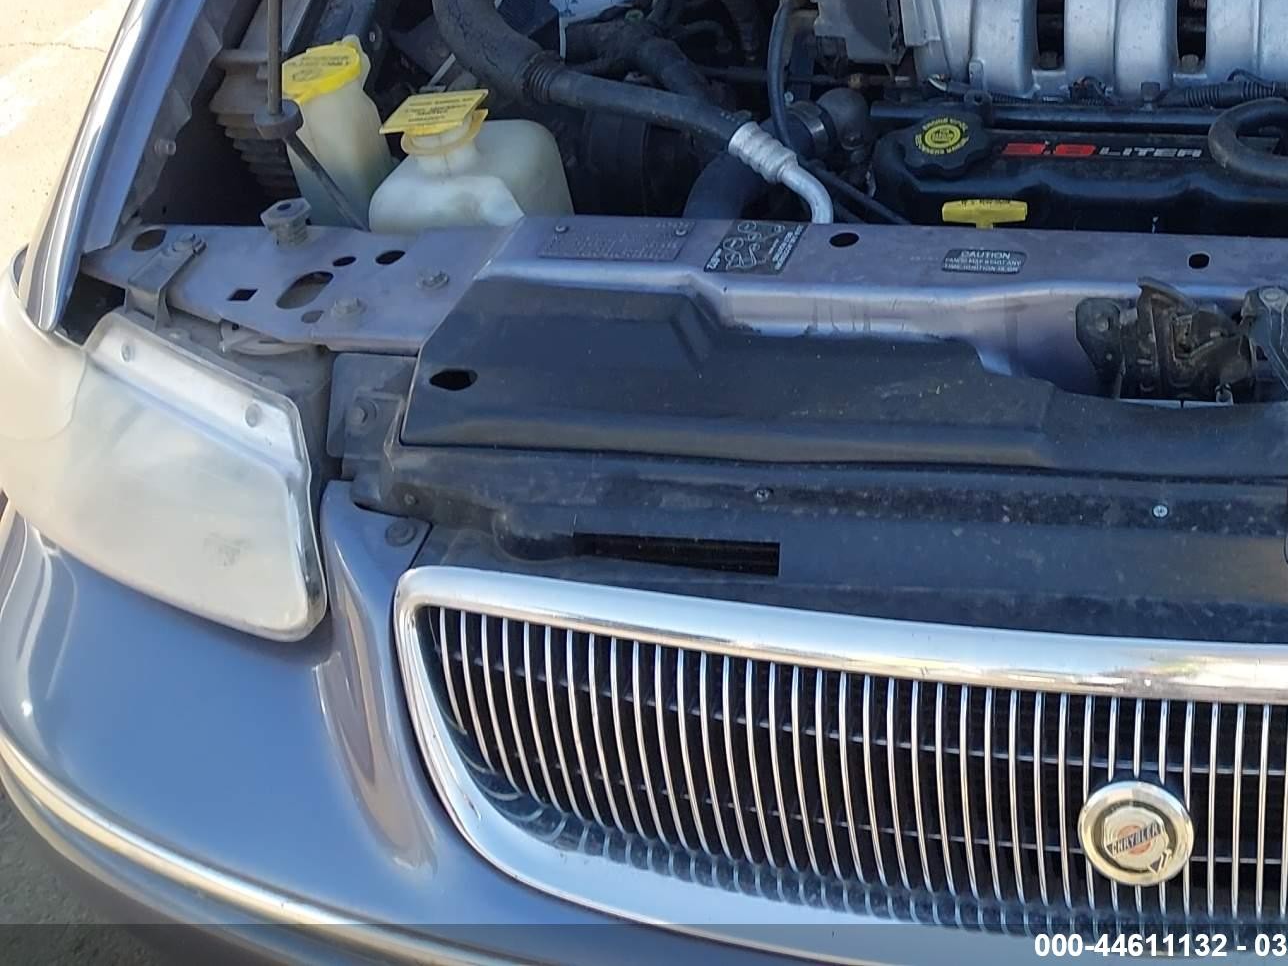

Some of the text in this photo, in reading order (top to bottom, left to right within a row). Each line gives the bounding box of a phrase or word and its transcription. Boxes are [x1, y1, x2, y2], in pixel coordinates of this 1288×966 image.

[1099, 146, 1203, 158] LITER
[961, 250, 1011, 260] CAUTION
[963, 264, 996, 272] IGNITION
